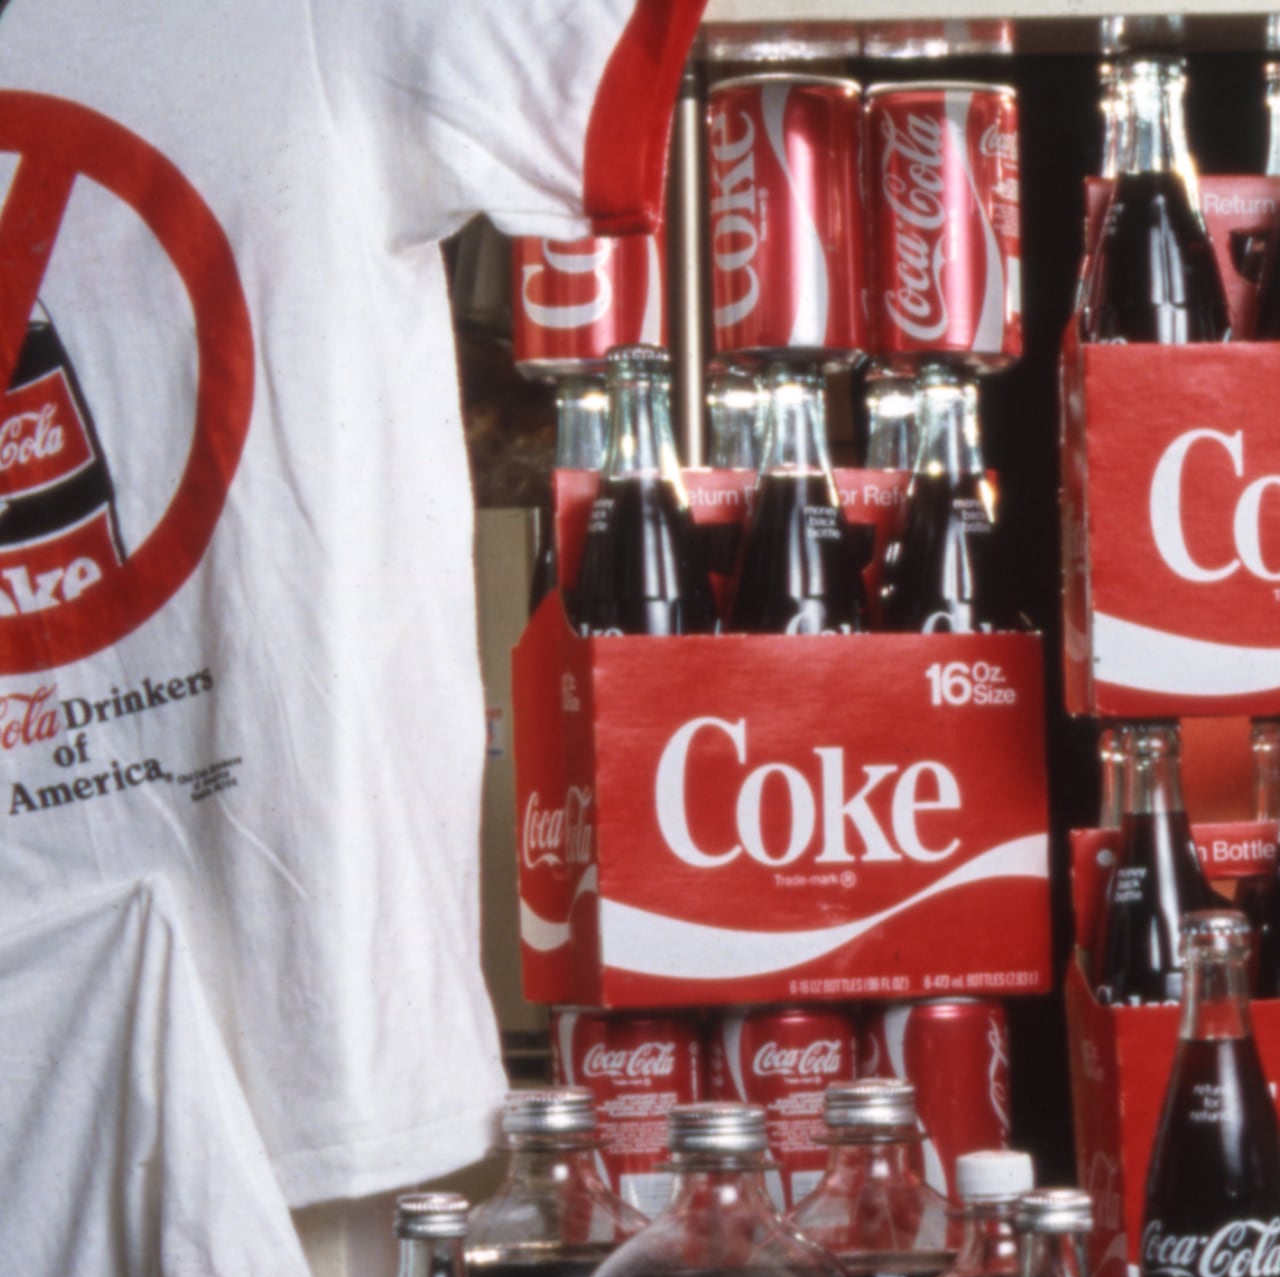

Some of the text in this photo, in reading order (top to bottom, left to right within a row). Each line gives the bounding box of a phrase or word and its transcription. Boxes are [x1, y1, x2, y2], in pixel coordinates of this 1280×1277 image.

[1202, 194, 1276, 215] Return
[687, 485, 739, 507] eturn
[61, 666, 214, 730] Drinkers
[926, 662, 1006, 706] 16 Oz.
[972, 685, 1016, 705] Size
[53, 731, 90, 769] of
[655, 716, 962, 869] Coke
[1213, 840, 1277, 863] Bottle
